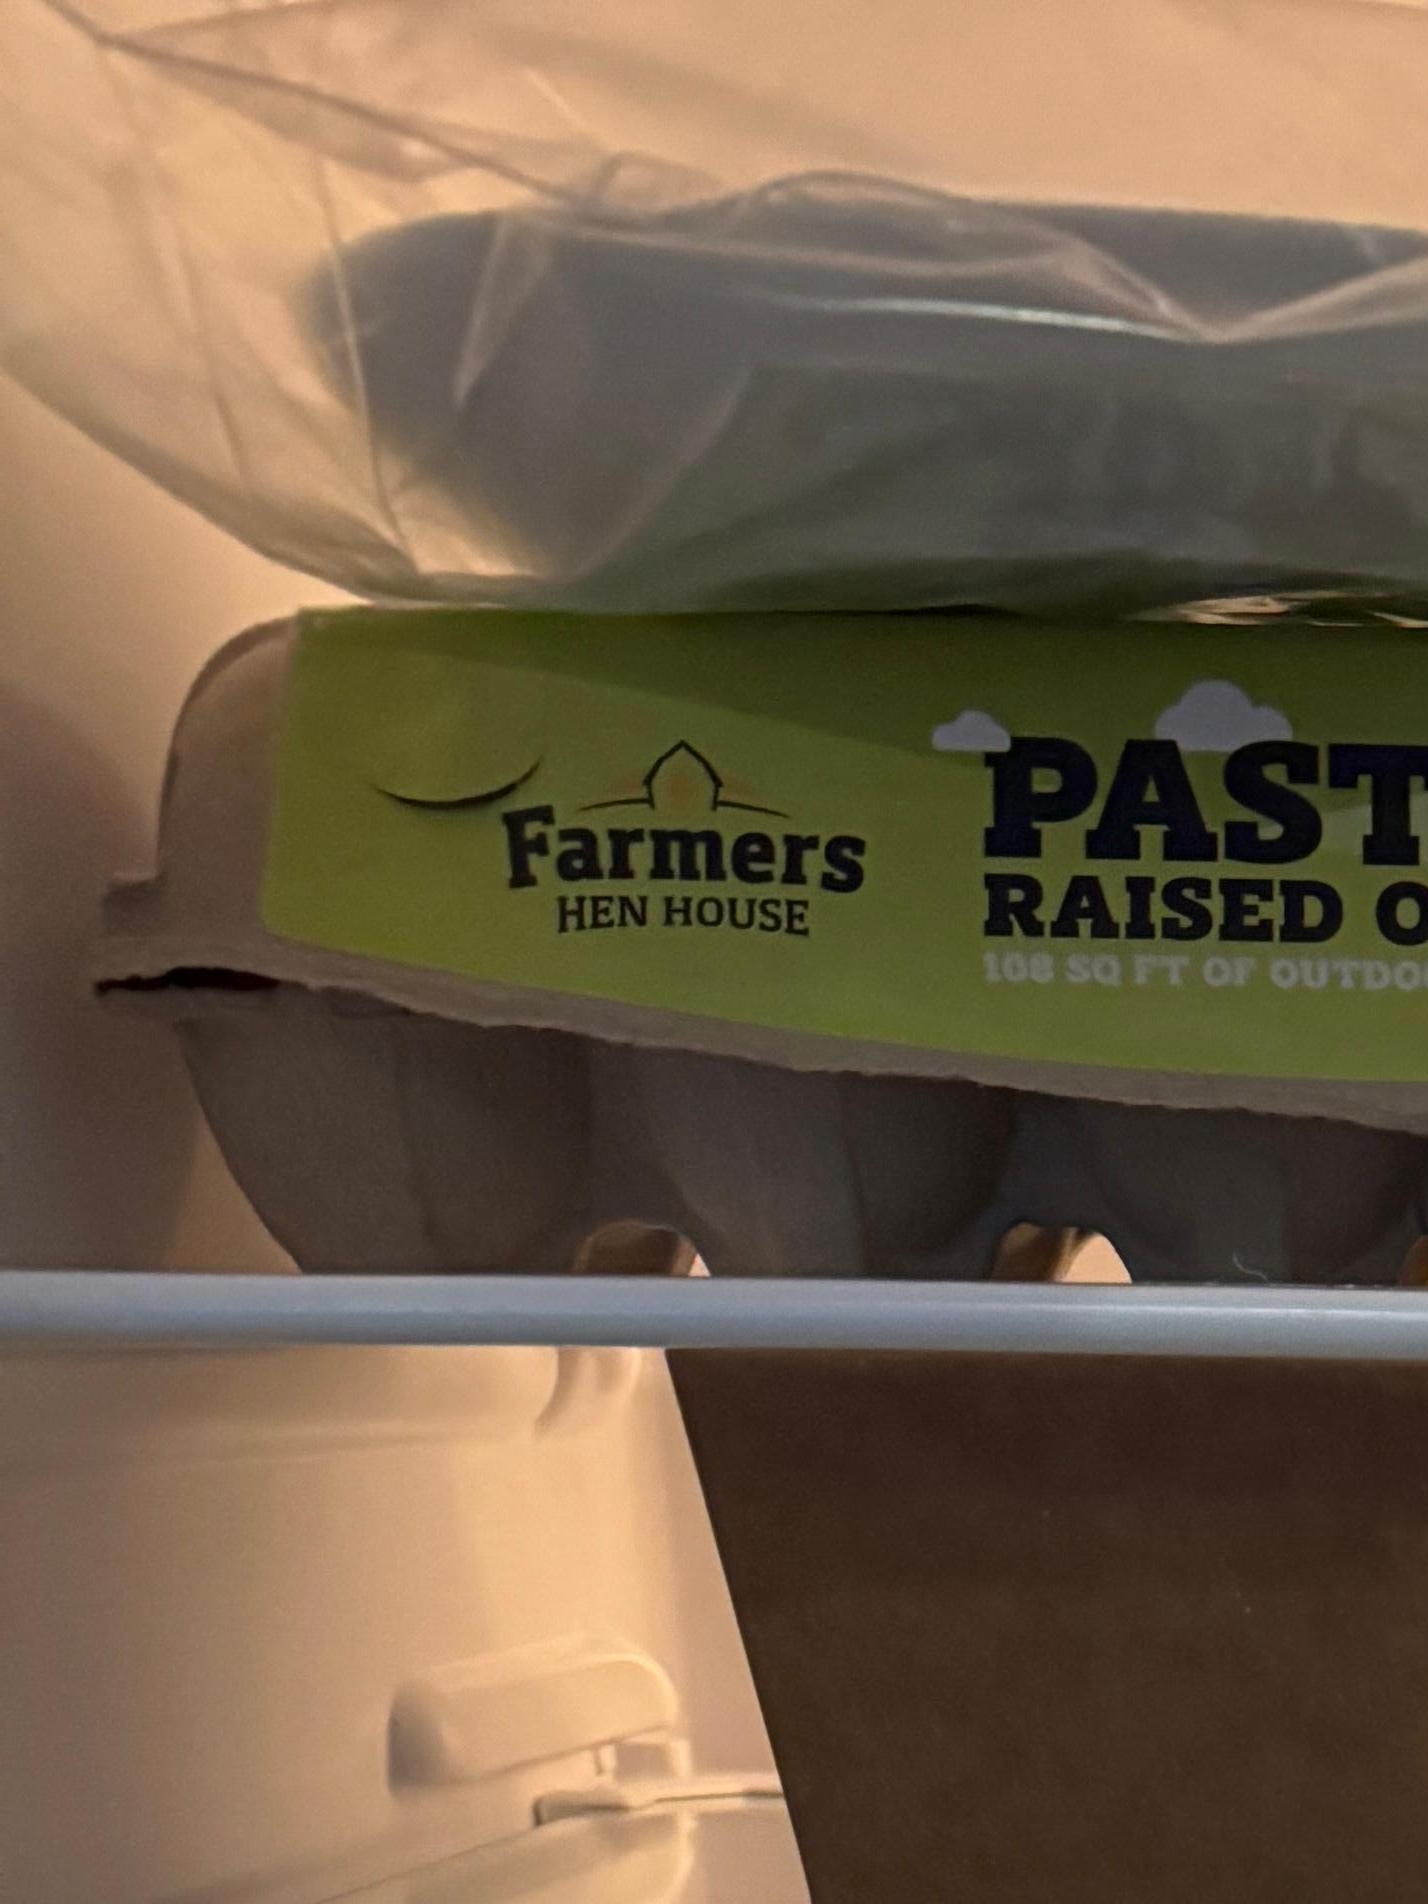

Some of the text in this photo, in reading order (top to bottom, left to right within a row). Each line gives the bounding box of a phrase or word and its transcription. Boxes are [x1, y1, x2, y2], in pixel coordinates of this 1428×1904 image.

[502, 805, 867, 893] Farmers
[557, 895, 810, 936] HEN HOUSE
[984, 873, 1343, 943] RAISED
[984, 953, 1053, 984] 108
[1066, 953, 1122, 986] SQ
[1134, 954, 1185, 985] FT
[1203, 956, 1257, 986] OF
